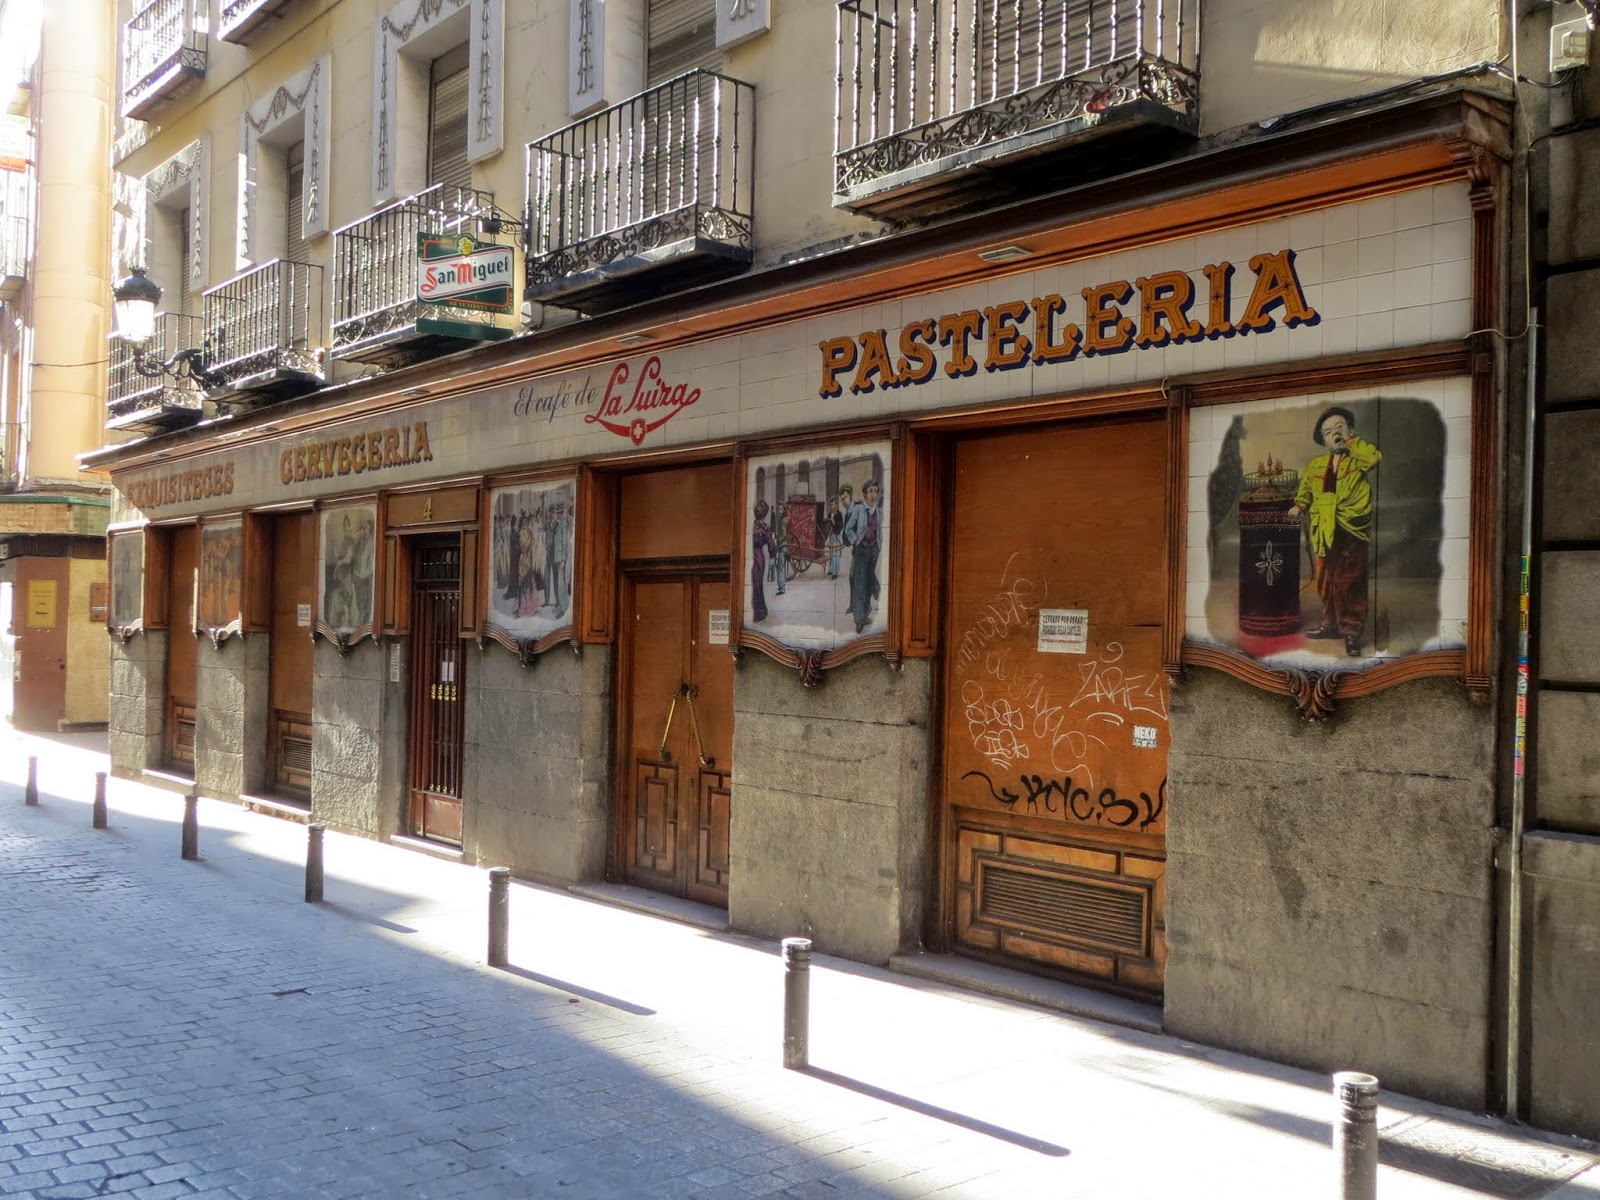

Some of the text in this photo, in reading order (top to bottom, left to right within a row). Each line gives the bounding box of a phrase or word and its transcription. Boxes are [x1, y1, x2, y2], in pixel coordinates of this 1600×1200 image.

[420, 256, 509, 293] San Miguel
[818, 249, 1321, 399] PASTELERIA
[513, 387, 533, 417] El
[535, 379, 572, 423] café
[574, 376, 598, 405] de
[584, 362, 630, 425] La
[280, 420, 433, 485] CERVECERIA
[423, 497, 432, 521] 4
[1134, 725, 1156, 740] NEKO
